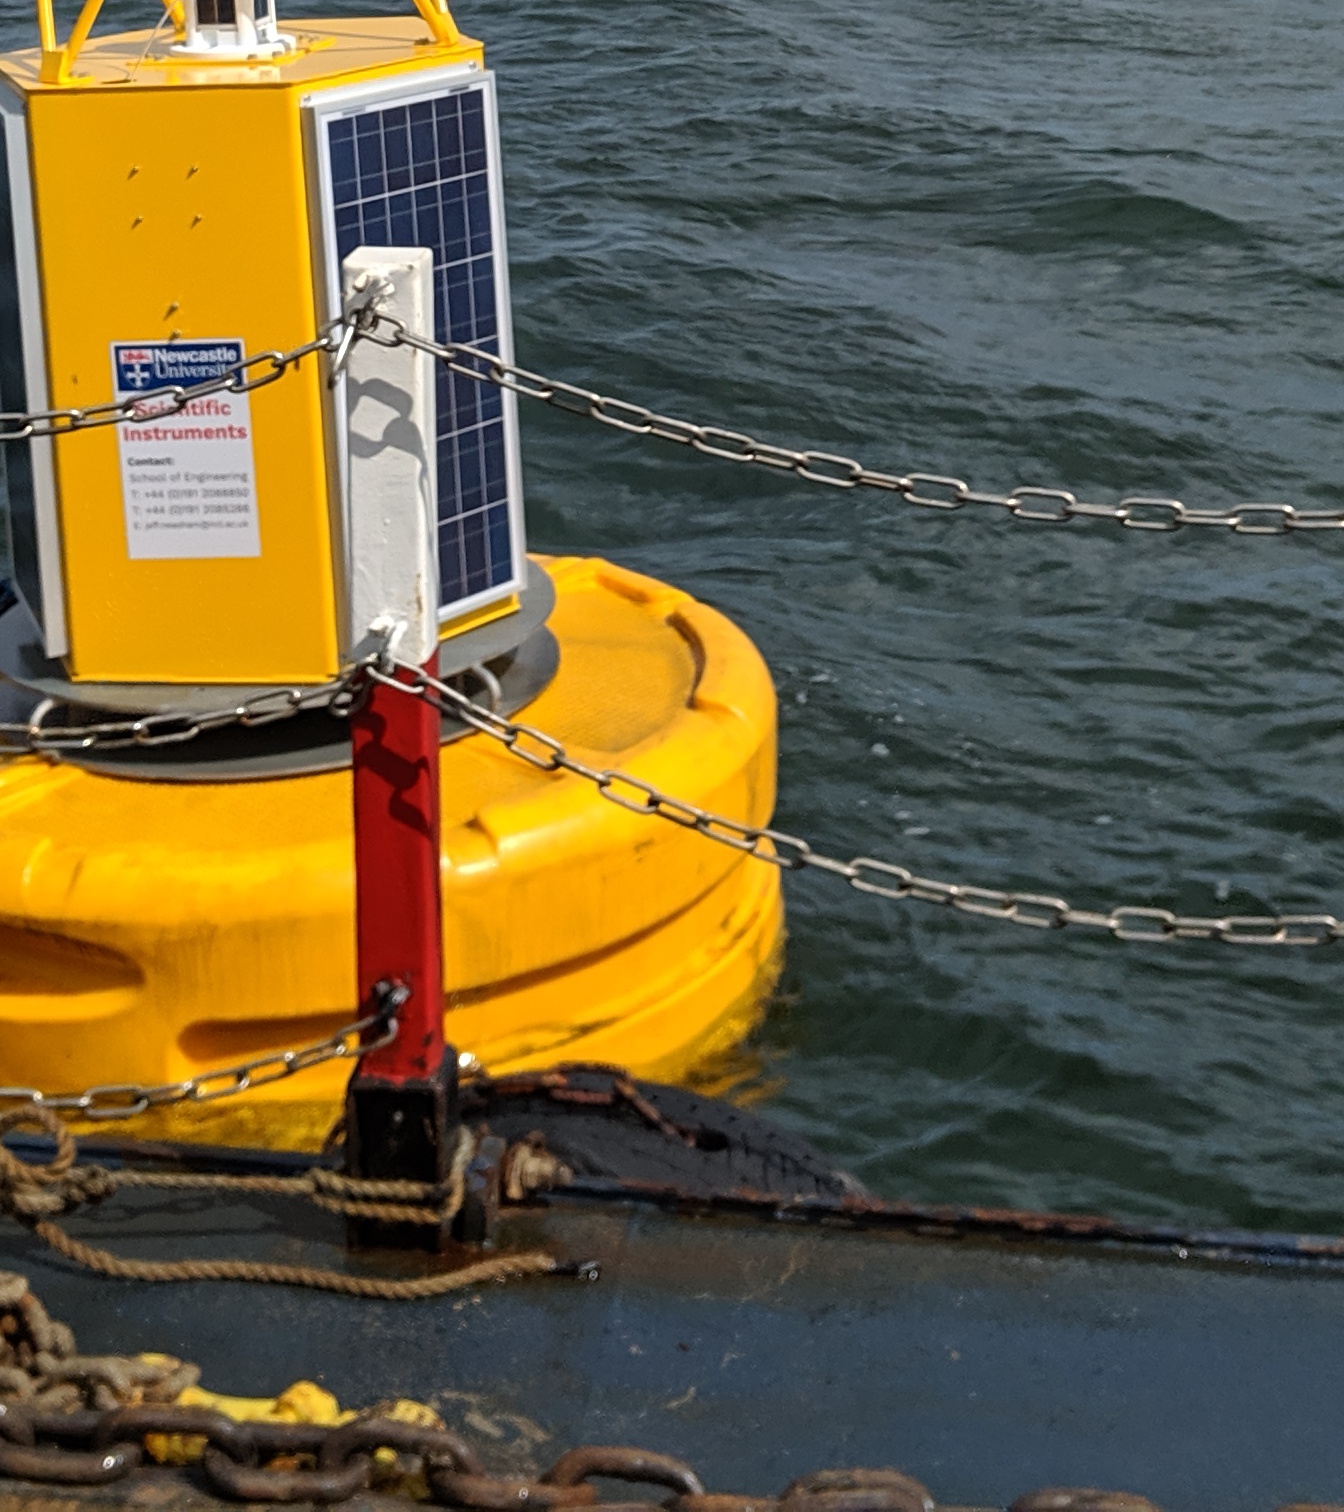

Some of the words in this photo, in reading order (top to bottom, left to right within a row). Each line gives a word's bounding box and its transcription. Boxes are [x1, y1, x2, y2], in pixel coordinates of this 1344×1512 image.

[154, 346, 237, 364] Newcastle
[154, 361, 233, 379] Universit
[133, 398, 232, 418] Scintific
[122, 423, 248, 442] Instruments
[169, 472, 181, 482] of
[184, 472, 249, 484] Engineering
